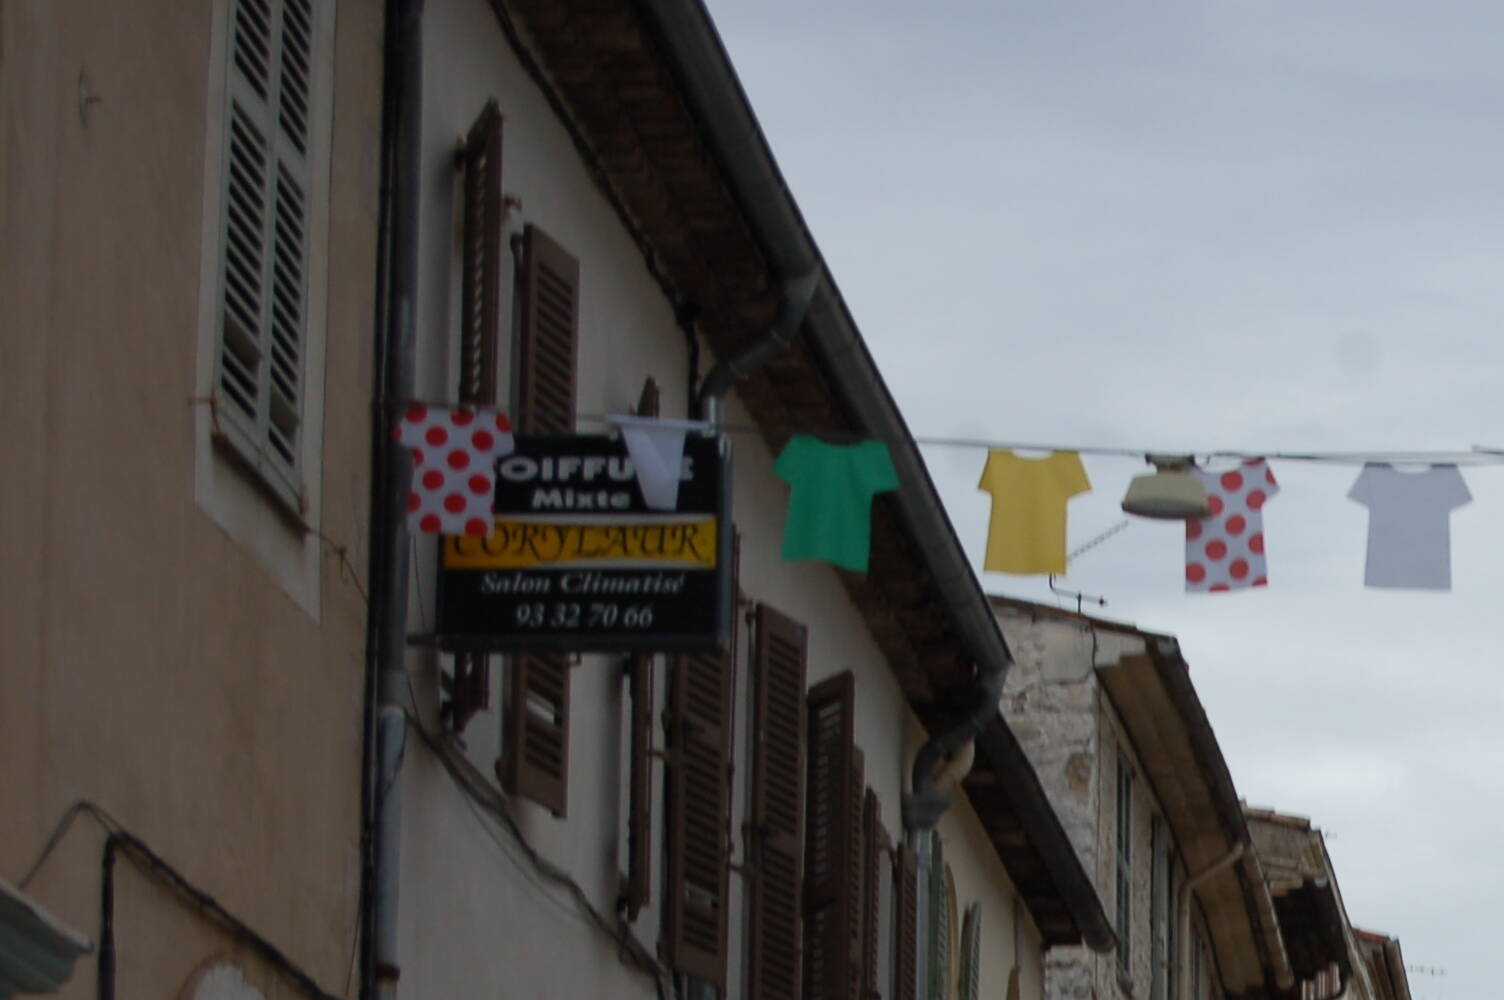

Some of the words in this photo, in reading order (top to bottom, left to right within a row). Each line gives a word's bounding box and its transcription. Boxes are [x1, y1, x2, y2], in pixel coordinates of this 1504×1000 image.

[499, 455, 694, 482] OIFFUE
[531, 487, 632, 510] Mixte
[481, 571, 552, 594] Salon
[559, 571, 687, 594] Climatisé
[516, 602, 545, 629] 93
[550, 602, 581, 629] 32
[588, 602, 619, 629] 70
[623, 602, 654, 629] 66
